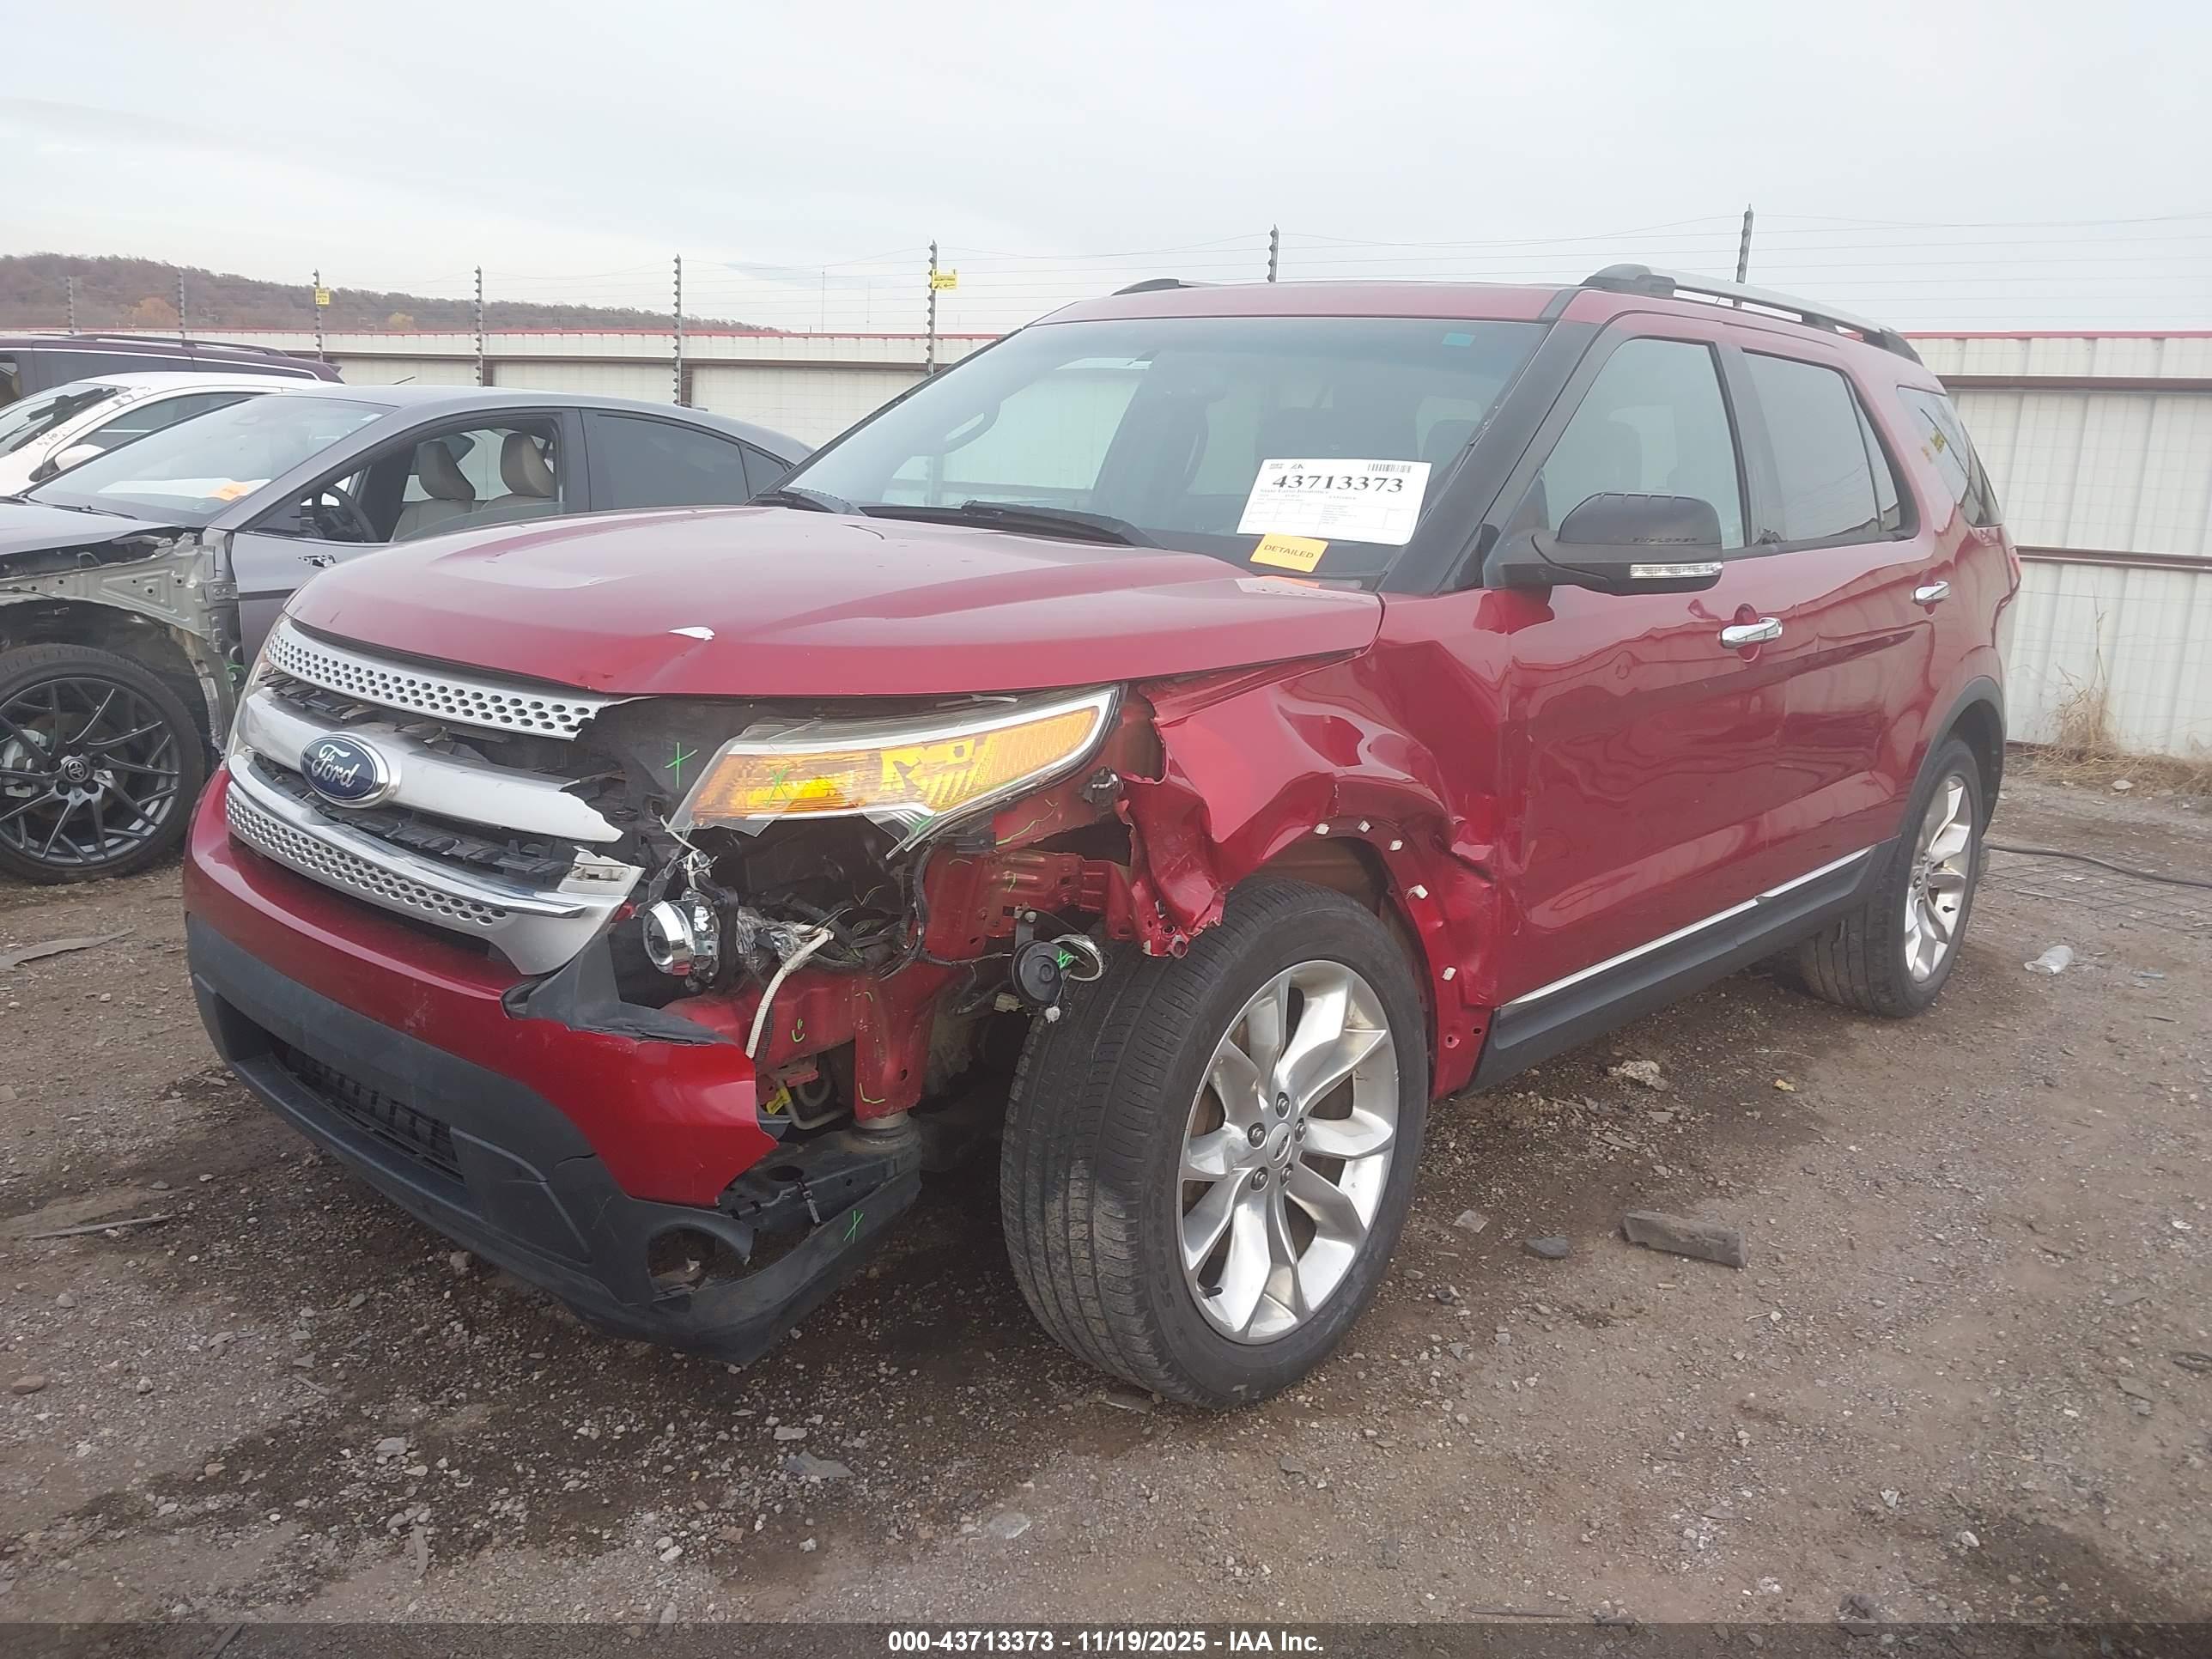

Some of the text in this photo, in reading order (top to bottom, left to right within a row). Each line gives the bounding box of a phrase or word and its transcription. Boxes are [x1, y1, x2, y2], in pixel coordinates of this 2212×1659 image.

[1273, 475, 1403, 493] 43713373
[1264, 544, 1315, 559] DETAILED
[311, 744, 361, 788] Ford
